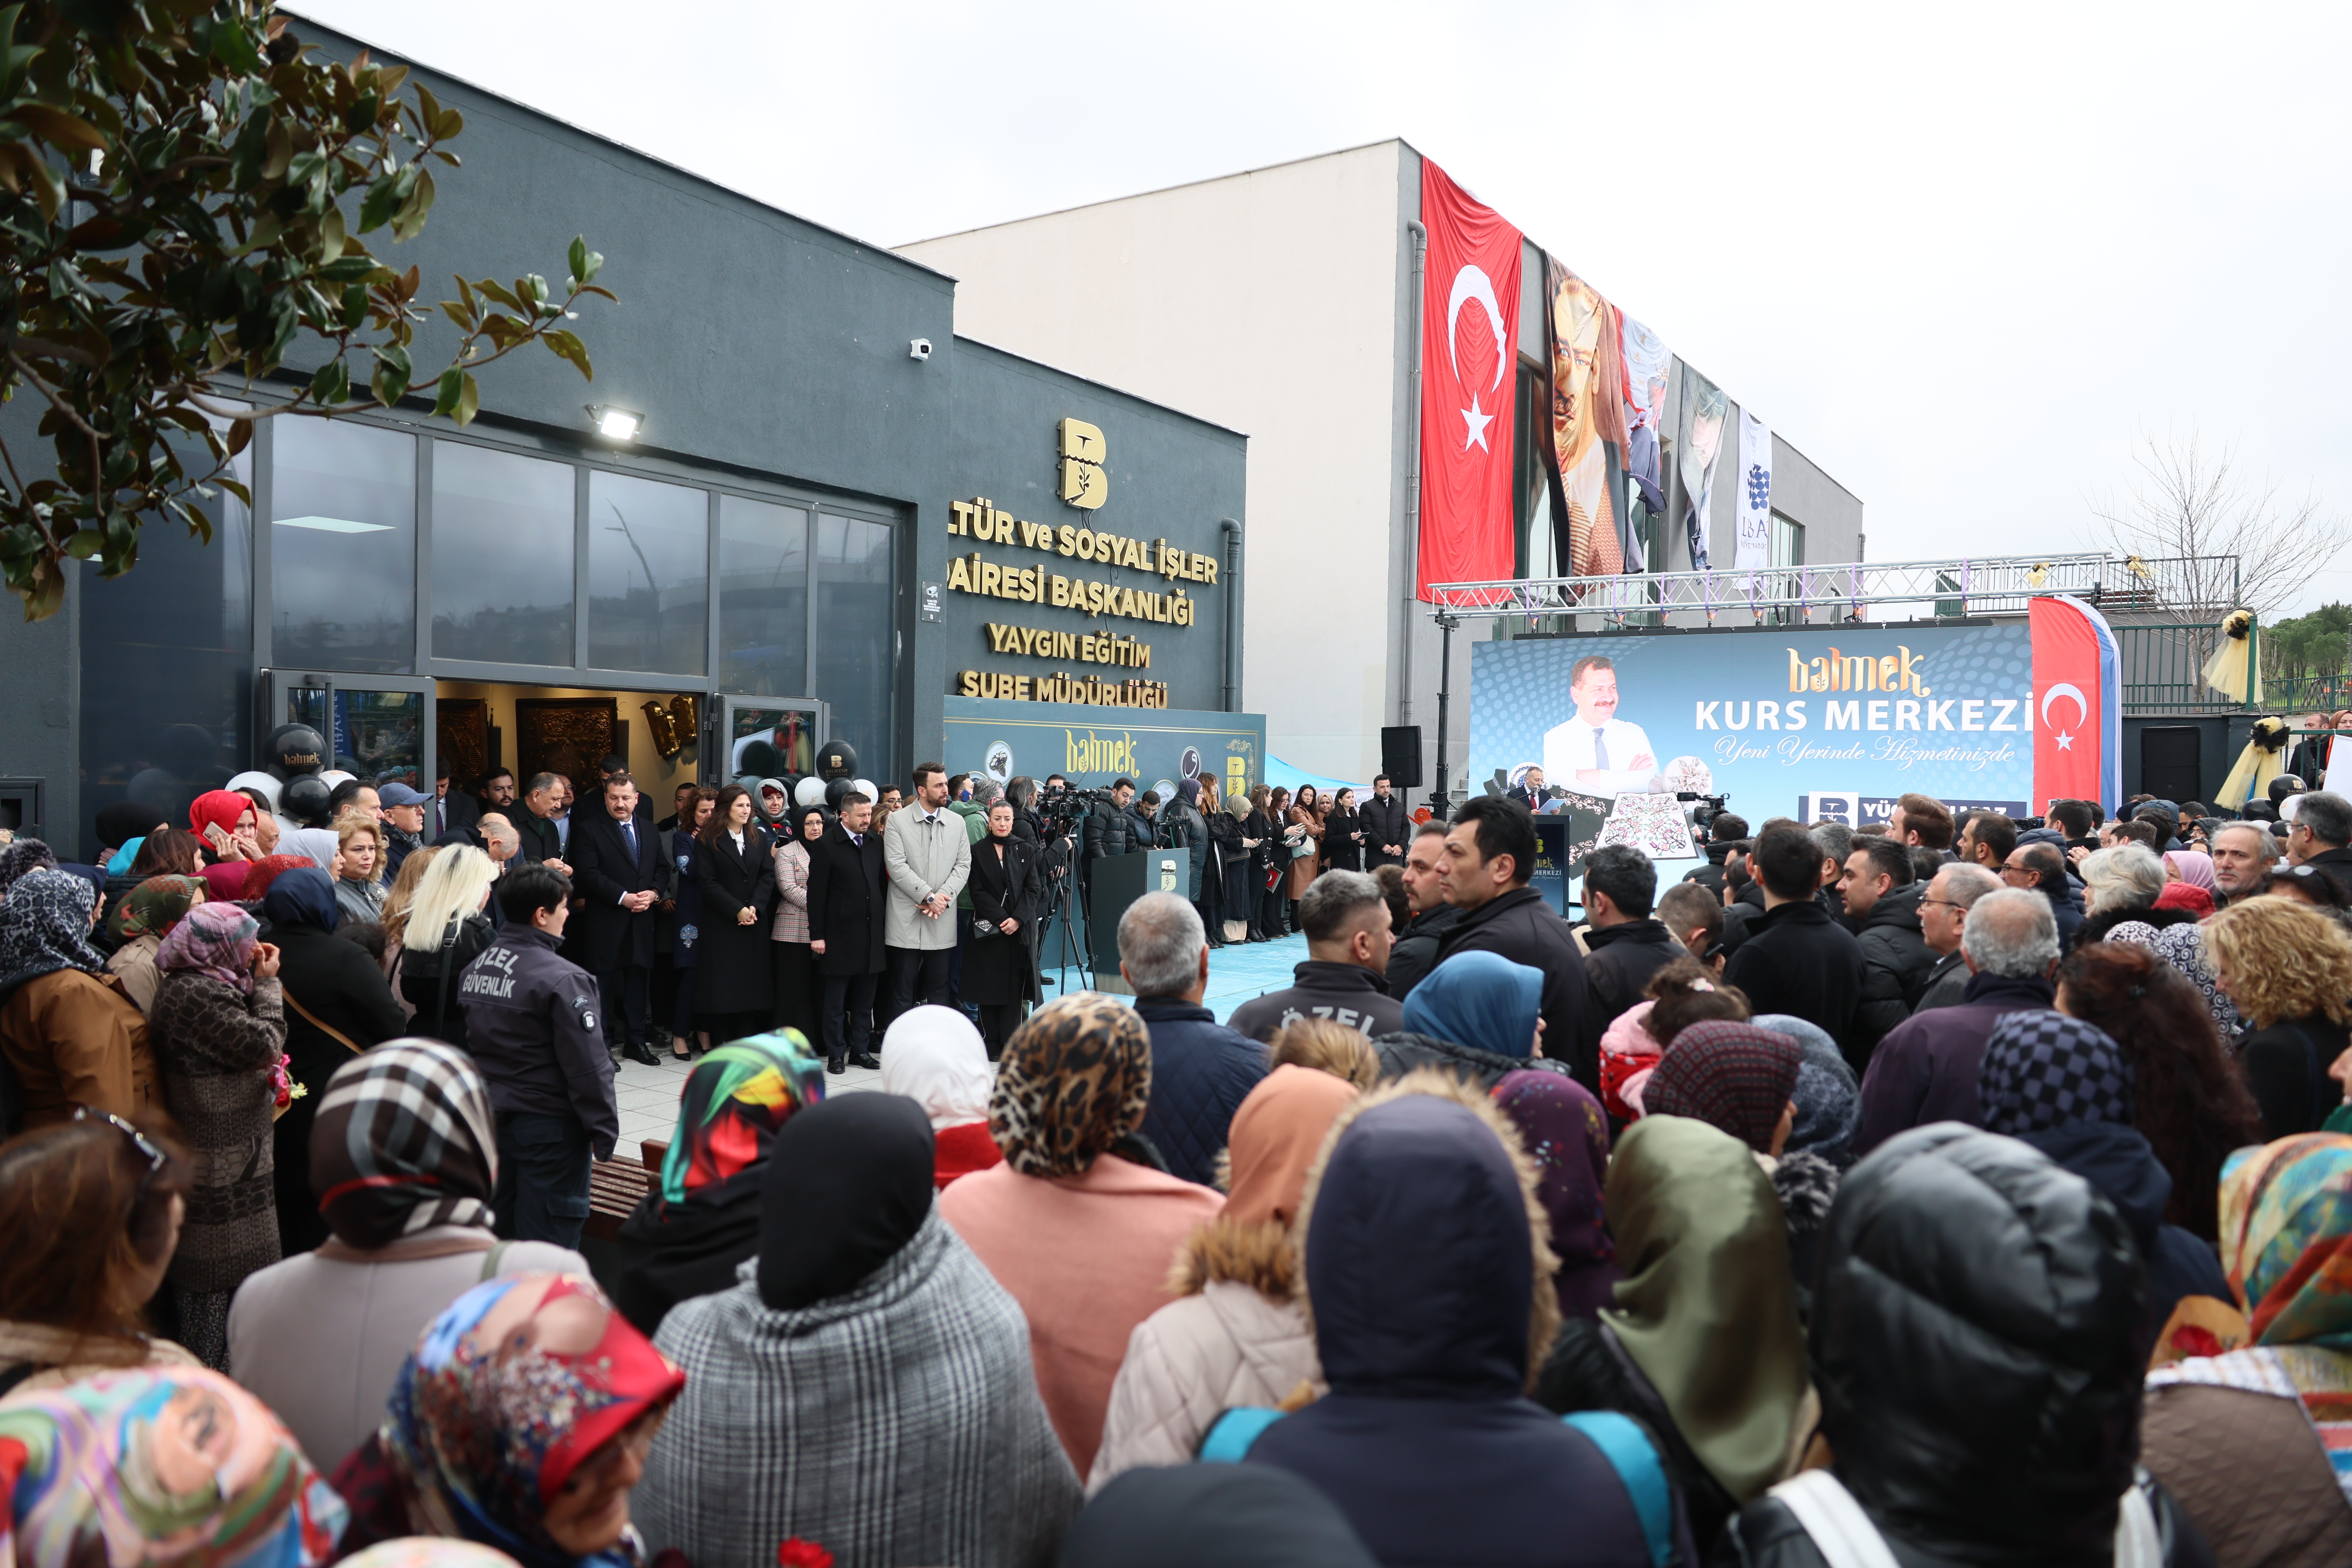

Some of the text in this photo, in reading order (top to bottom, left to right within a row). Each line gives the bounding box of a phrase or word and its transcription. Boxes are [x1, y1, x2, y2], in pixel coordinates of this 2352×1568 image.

[1021, 520, 1053, 550] ve
[1059, 524, 1153, 571] SOSYAL
[1159, 538, 1218, 585] İŞLER
[947, 552, 1194, 626] AİRESİ BAŞKANLIĞI
[989, 622, 1151, 668] YAYGIN EĞİTİM
[1036, 671, 1168, 709] MÜDÜRLÜĞÜ
[1695, 691, 2034, 731] KURS MERKEZİ
[1714, 735, 2015, 772] Yeni Yerinde Hizmetinizde
[463, 970, 516, 998] GÜVENLİK
